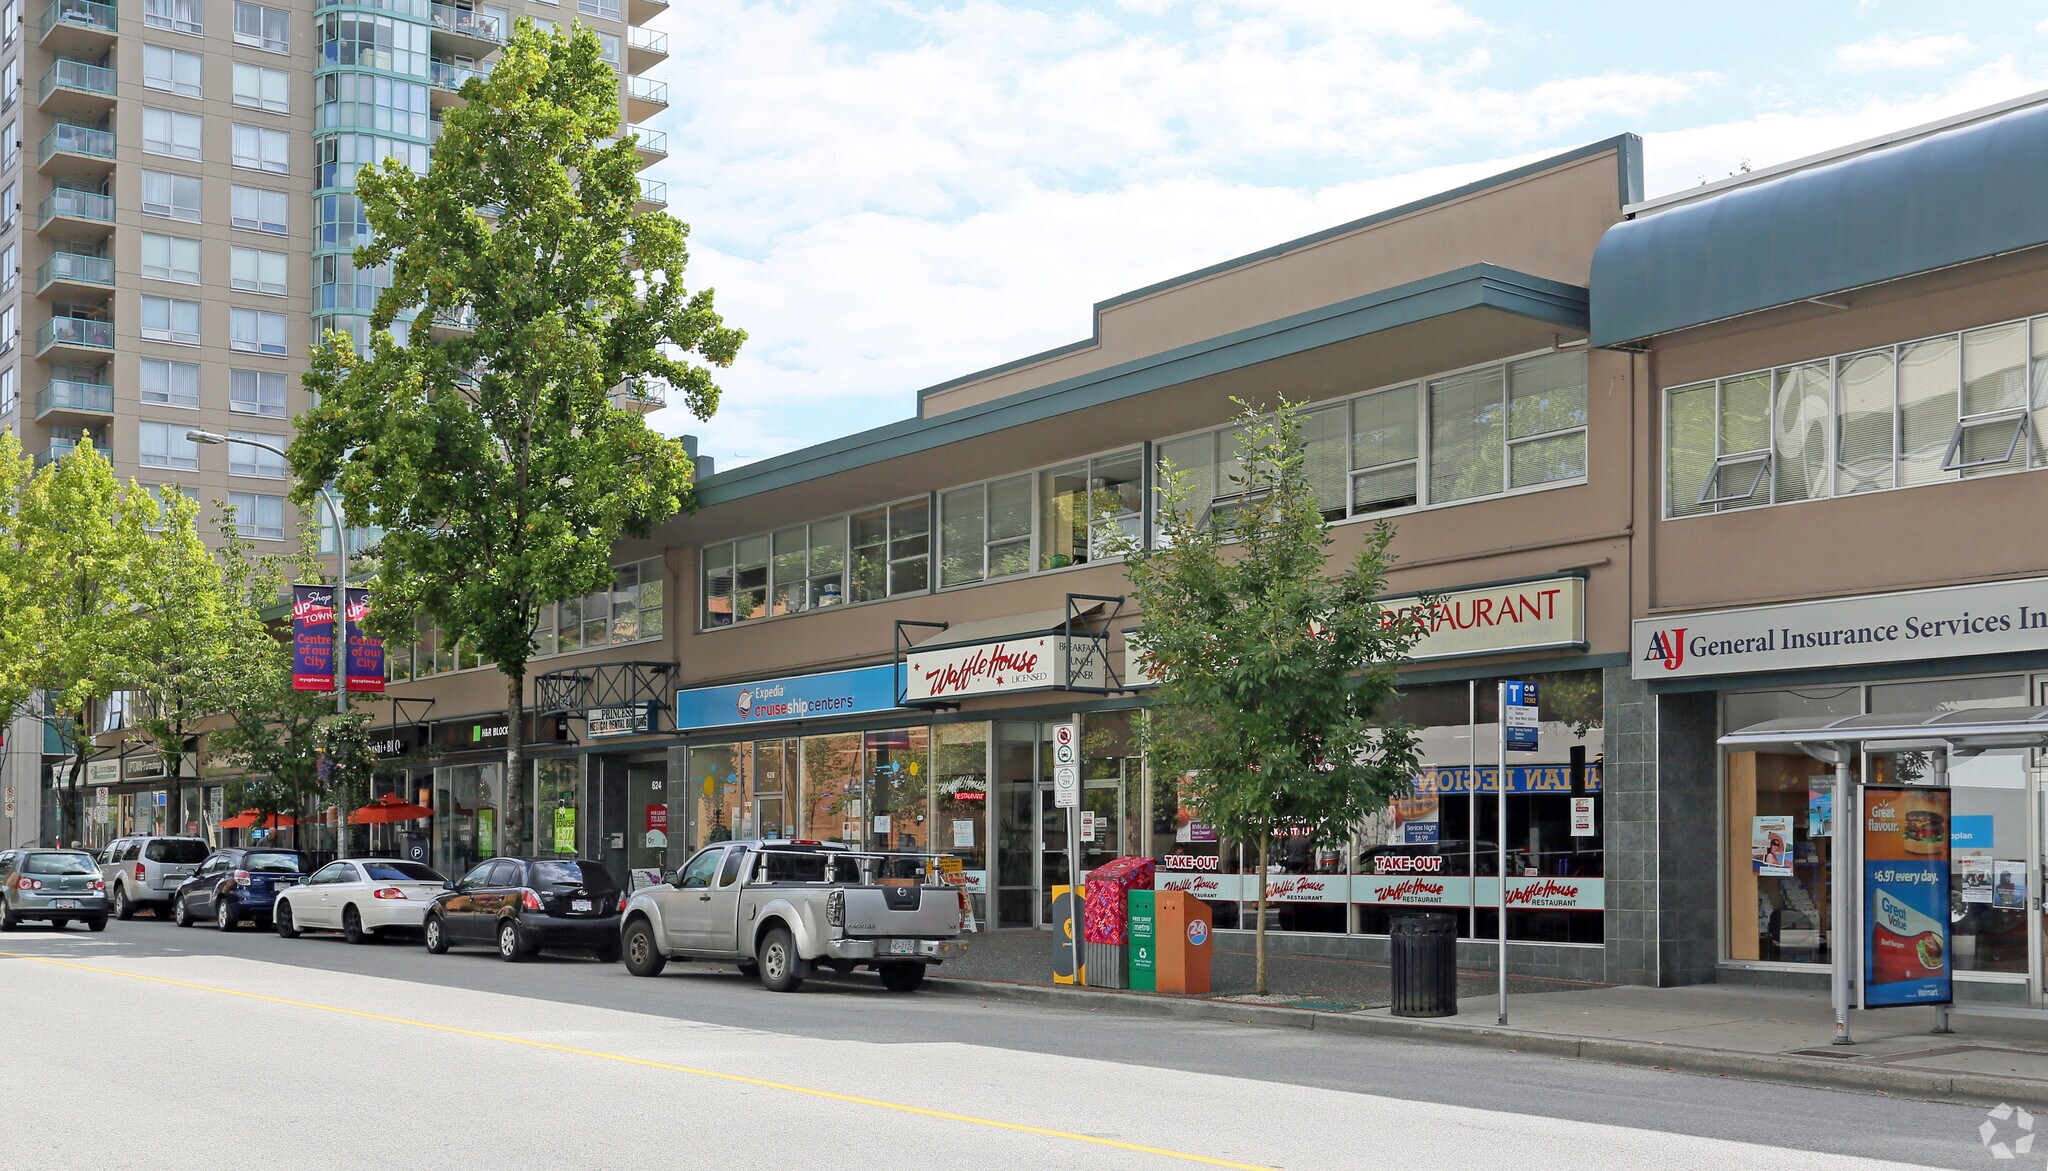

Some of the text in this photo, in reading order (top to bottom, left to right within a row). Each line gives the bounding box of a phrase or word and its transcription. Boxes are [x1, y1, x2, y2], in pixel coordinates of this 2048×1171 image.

[308, 592, 332, 605] Shop
[294, 602, 311, 616] UP
[347, 605, 363, 618] UP
[304, 611, 333, 624] TOWN
[297, 633, 332, 645] Centre
[350, 635, 382, 646] Centre
[1689, 628, 1774, 659] General
[1781, 620, 1899, 650] Insurance
[1905, 612, 2011, 640] Services
[299, 644, 311, 655] of
[352, 646, 363, 657] of
[304, 656, 326, 669] City
[356, 658, 377, 670] City
[1070, 657, 1093, 667] UNCH
[926, 644, 1038, 697] Waffle House
[1011, 672, 1048, 684] LICENSED
[755, 684, 784, 701] Expedia
[755, 696, 854, 717] cruiseshipcenters
[602, 708, 633, 720] PRINCESS
[482, 728, 492, 737] H&R
[652, 781, 662, 790] 624
[955, 791, 985, 800] RESTAURANT
[1871, 806, 1895, 818] Great
[556, 820, 575, 828] course
[1423, 824, 1437, 832] Night
[1868, 819, 1899, 832] flavour.
[556, 827, 574, 840] 1-877
[1165, 855, 1218, 870] TAKE-OUT
[1375, 856, 1442, 871] TAKE-OUT
[1164, 875, 1219, 891] Waffle House
[1874, 869, 1939, 885] $6.97 every day.
[1265, 877, 1325, 898] Waffle House
[1375, 878, 1444, 902] Waffle House
[1504, 879, 1579, 904] Waffle House
[1402, 896, 1442, 904] RESTAURANT
[1531, 899, 1576, 907] RESTAURANT
[1882, 897, 1906, 920] Great
[1134, 923, 1151, 932] metro
[1190, 922, 1204, 935] 24
[1888, 914, 1907, 930] Value
[1891, 940, 1905, 949] Burgers
[1918, 988, 1938, 997] Walmart
